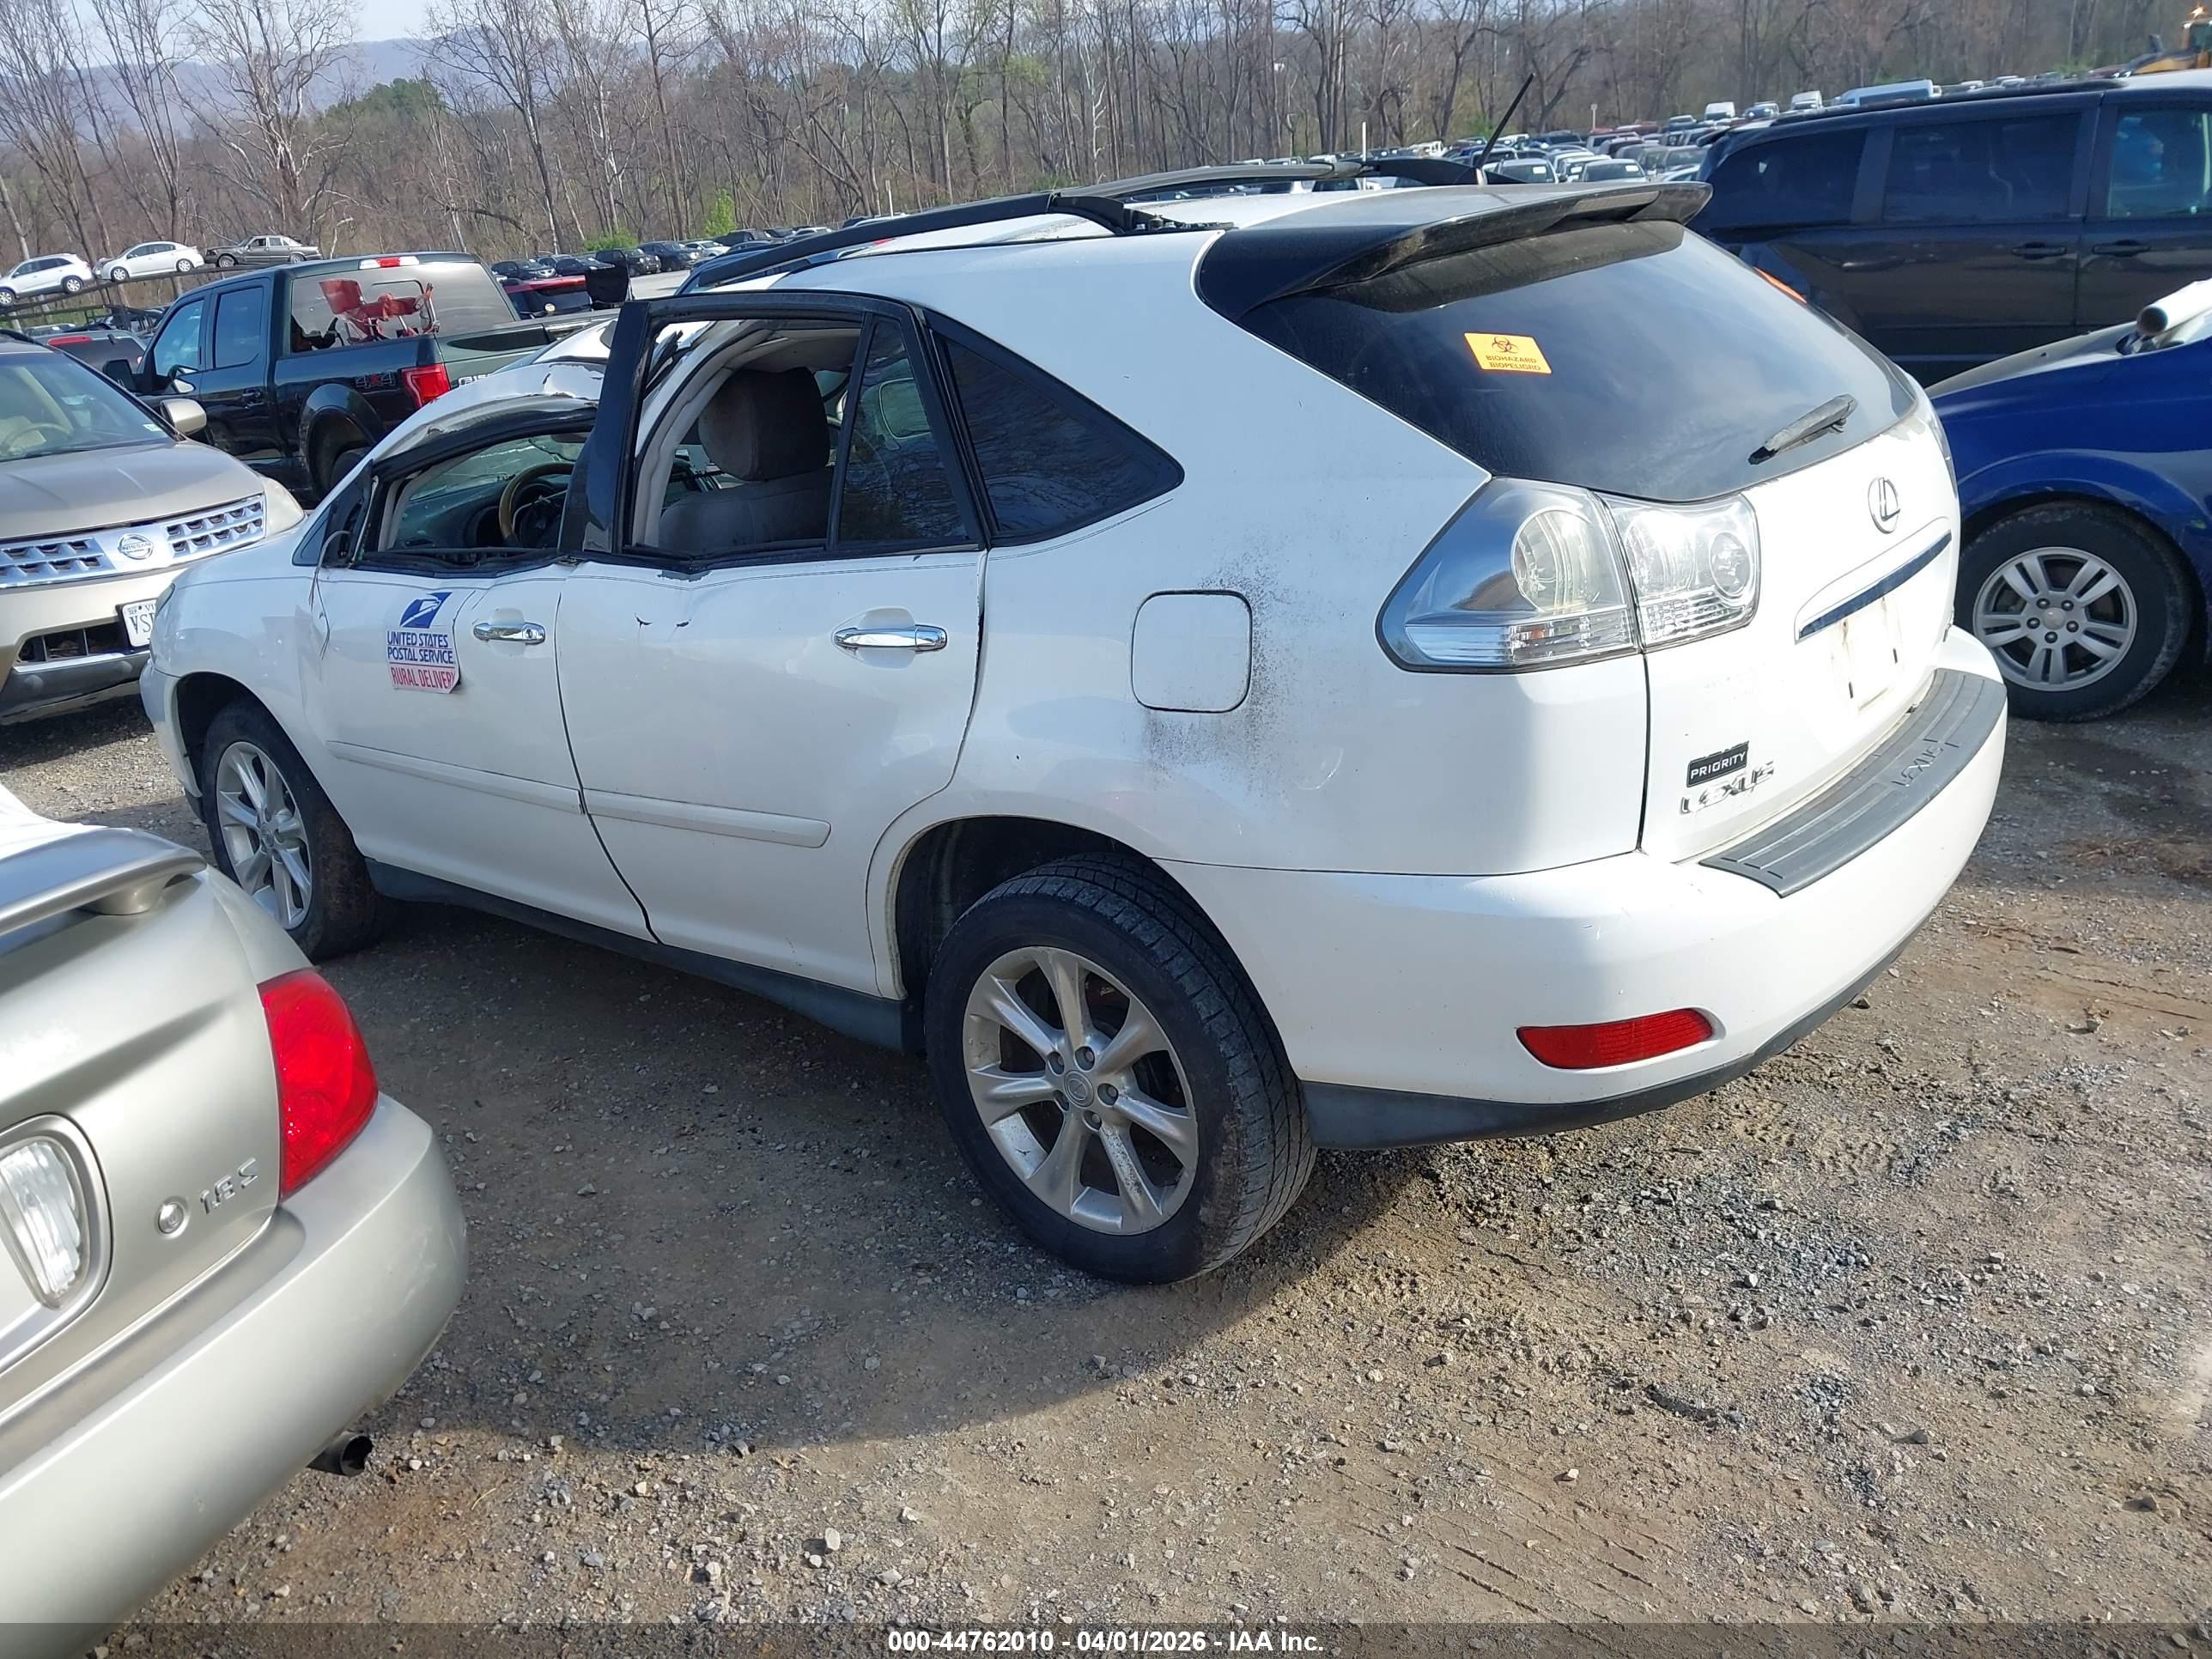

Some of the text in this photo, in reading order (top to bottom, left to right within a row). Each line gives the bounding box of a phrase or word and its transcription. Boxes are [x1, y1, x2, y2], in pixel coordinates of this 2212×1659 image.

[1486, 355, 1537, 364] BIOHAZARD
[1489, 362, 1541, 371] BIOPELIGRO
[129, 612, 155, 635] VS
[386, 630, 449, 648] UNITED STATES
[387, 646, 454, 665] POSTAL SERVICE
[390, 666, 420, 687] RURAL
[1690, 751, 1747, 780] PRIORITY
